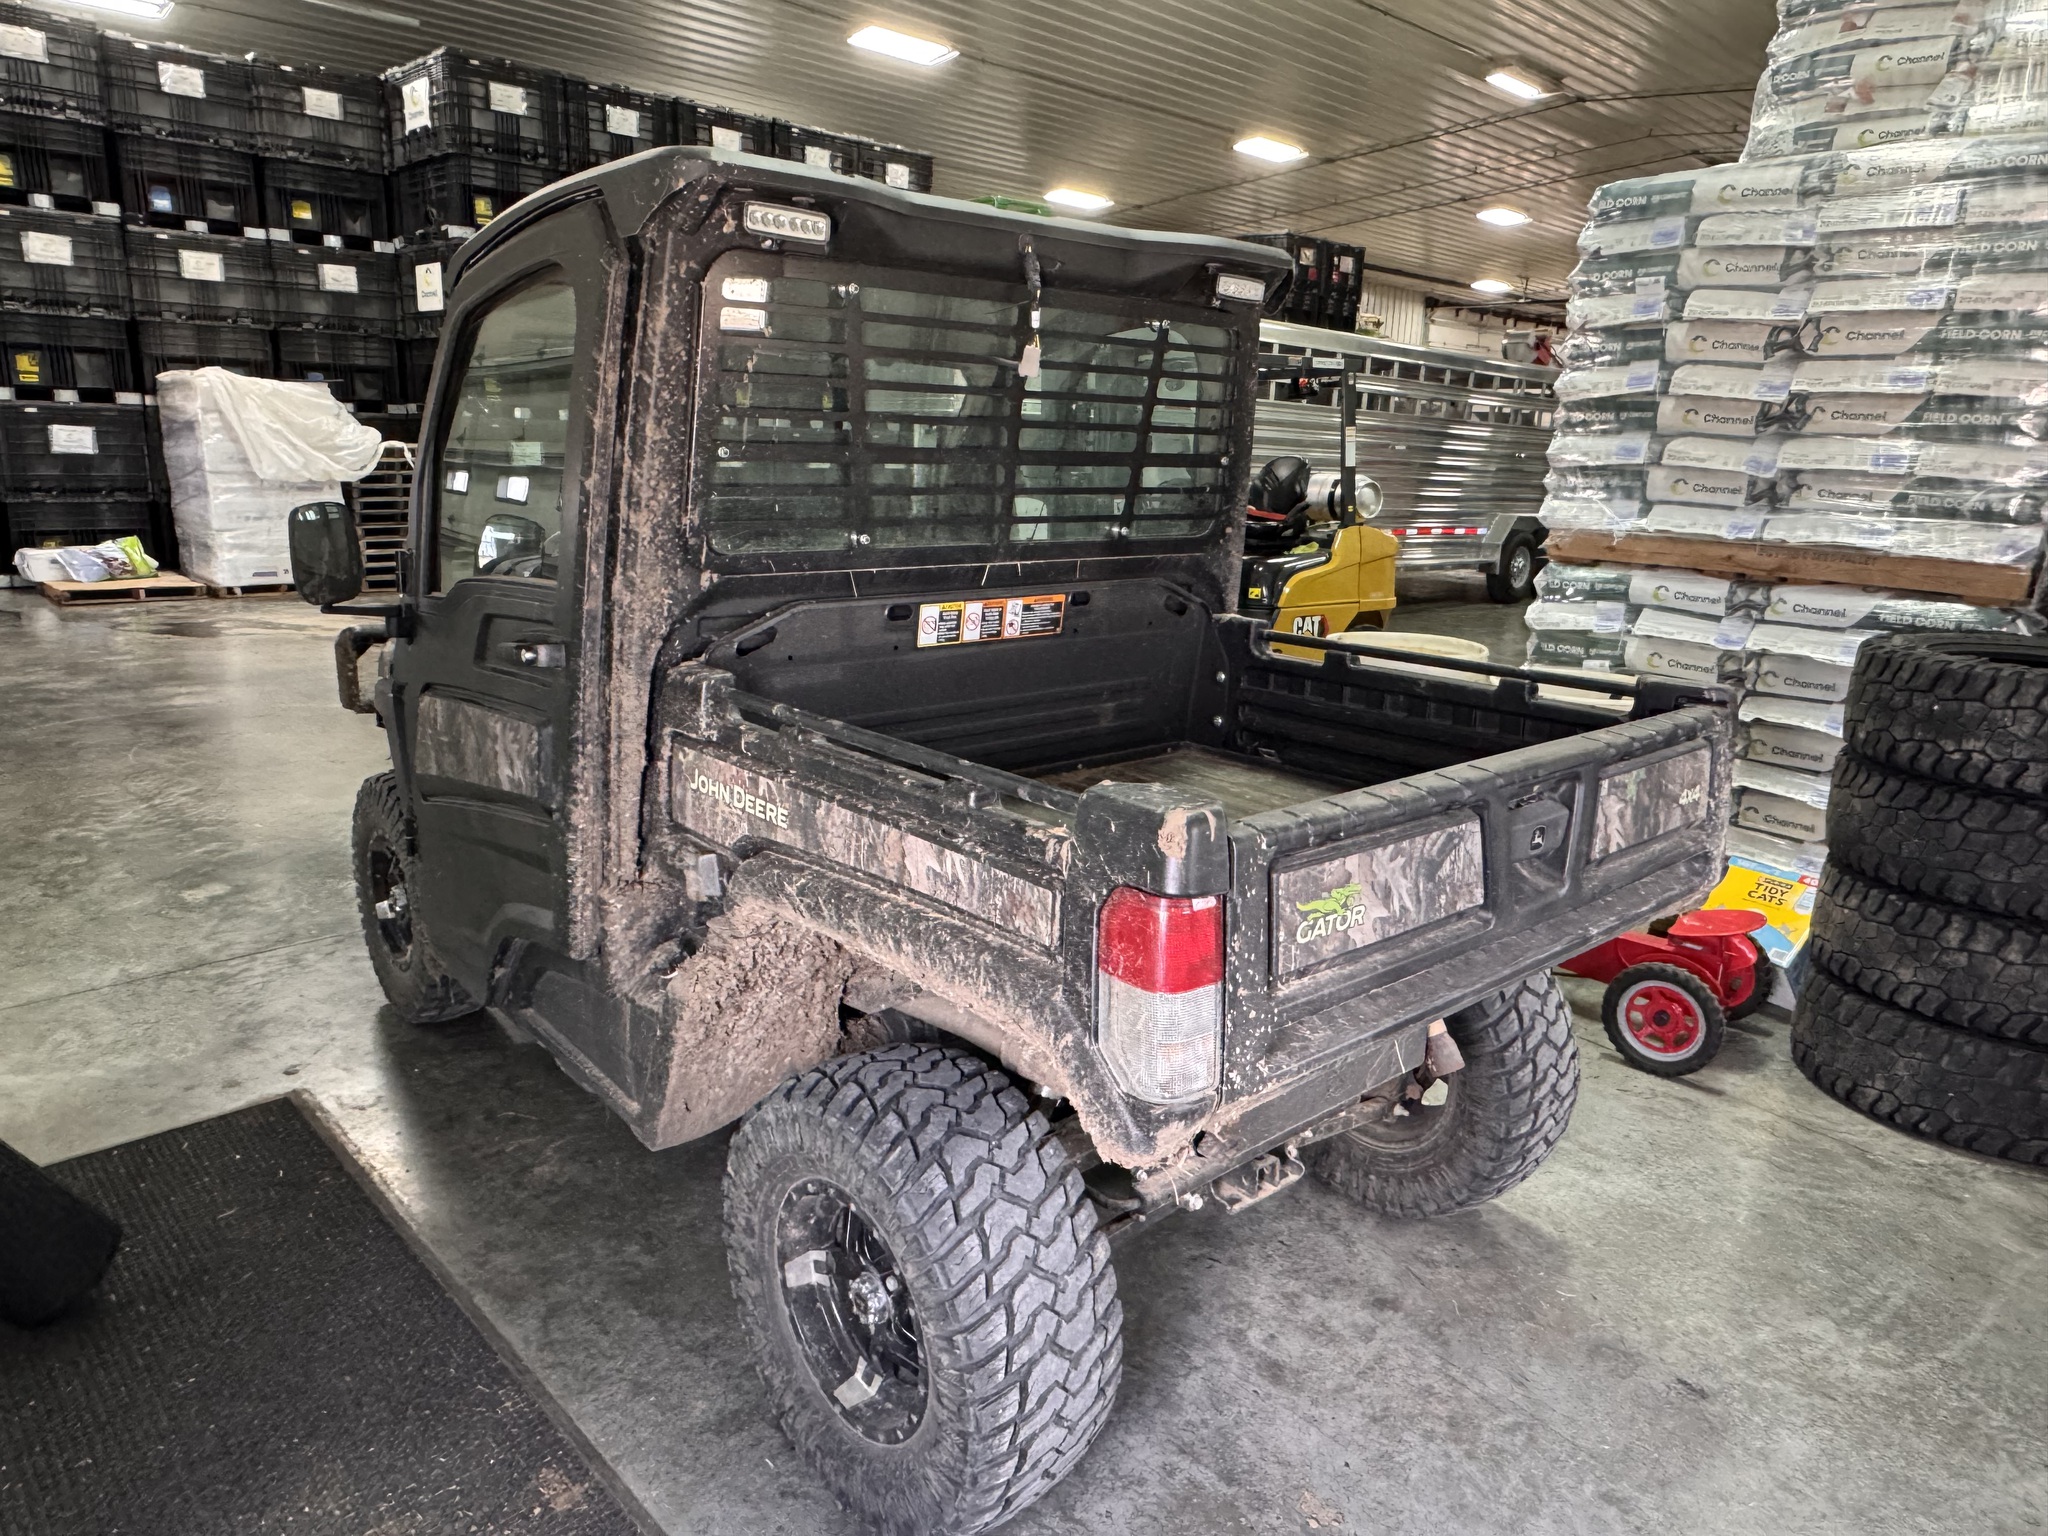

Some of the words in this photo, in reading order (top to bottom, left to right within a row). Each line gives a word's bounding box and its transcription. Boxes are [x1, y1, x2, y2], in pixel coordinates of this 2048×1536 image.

[1896, 51, 1945, 66] Channel
[1878, 126, 1926, 140] Channel
[2003, 154, 2048, 168] CORN
[1615, 195, 1647, 208] CORN
[1994, 240, 2039, 253] CORN
[1603, 268, 1633, 279] CORN
[1845, 328, 1905, 341] Channel
[1940, 328, 1976, 340] FIELD
[1977, 329, 2023, 341] CORN
[1703, 412, 1755, 425] Channel
[1830, 409, 1887, 422] Channel
[1922, 411, 1958, 423] FIELD
[1959, 413, 2002, 425] CORN
[1692, 482, 1744, 495] Channel
[1817, 487, 1873, 501] Channel
[1562, 580, 1591, 591] CORN
[1674, 590, 1722, 604] Channel
[1792, 602, 1847, 618] Channel
[1293, 615, 1322, 637] CAT
[1914, 615, 1956, 629] CORN
[1556, 644, 1585, 656] CORN
[1667, 658, 1716, 674] Channel
[1783, 676, 1836, 692] Channel
[1771, 745, 1824, 763] Channel
[690, 768, 730, 804] JOHN
[733, 785, 789, 830] DEERE
[1762, 813, 1816, 834] Channel
[1754, 882, 1789, 897] TIDY
[1747, 890, 1788, 906] CATS
[1296, 904, 1367, 944] GATOR
